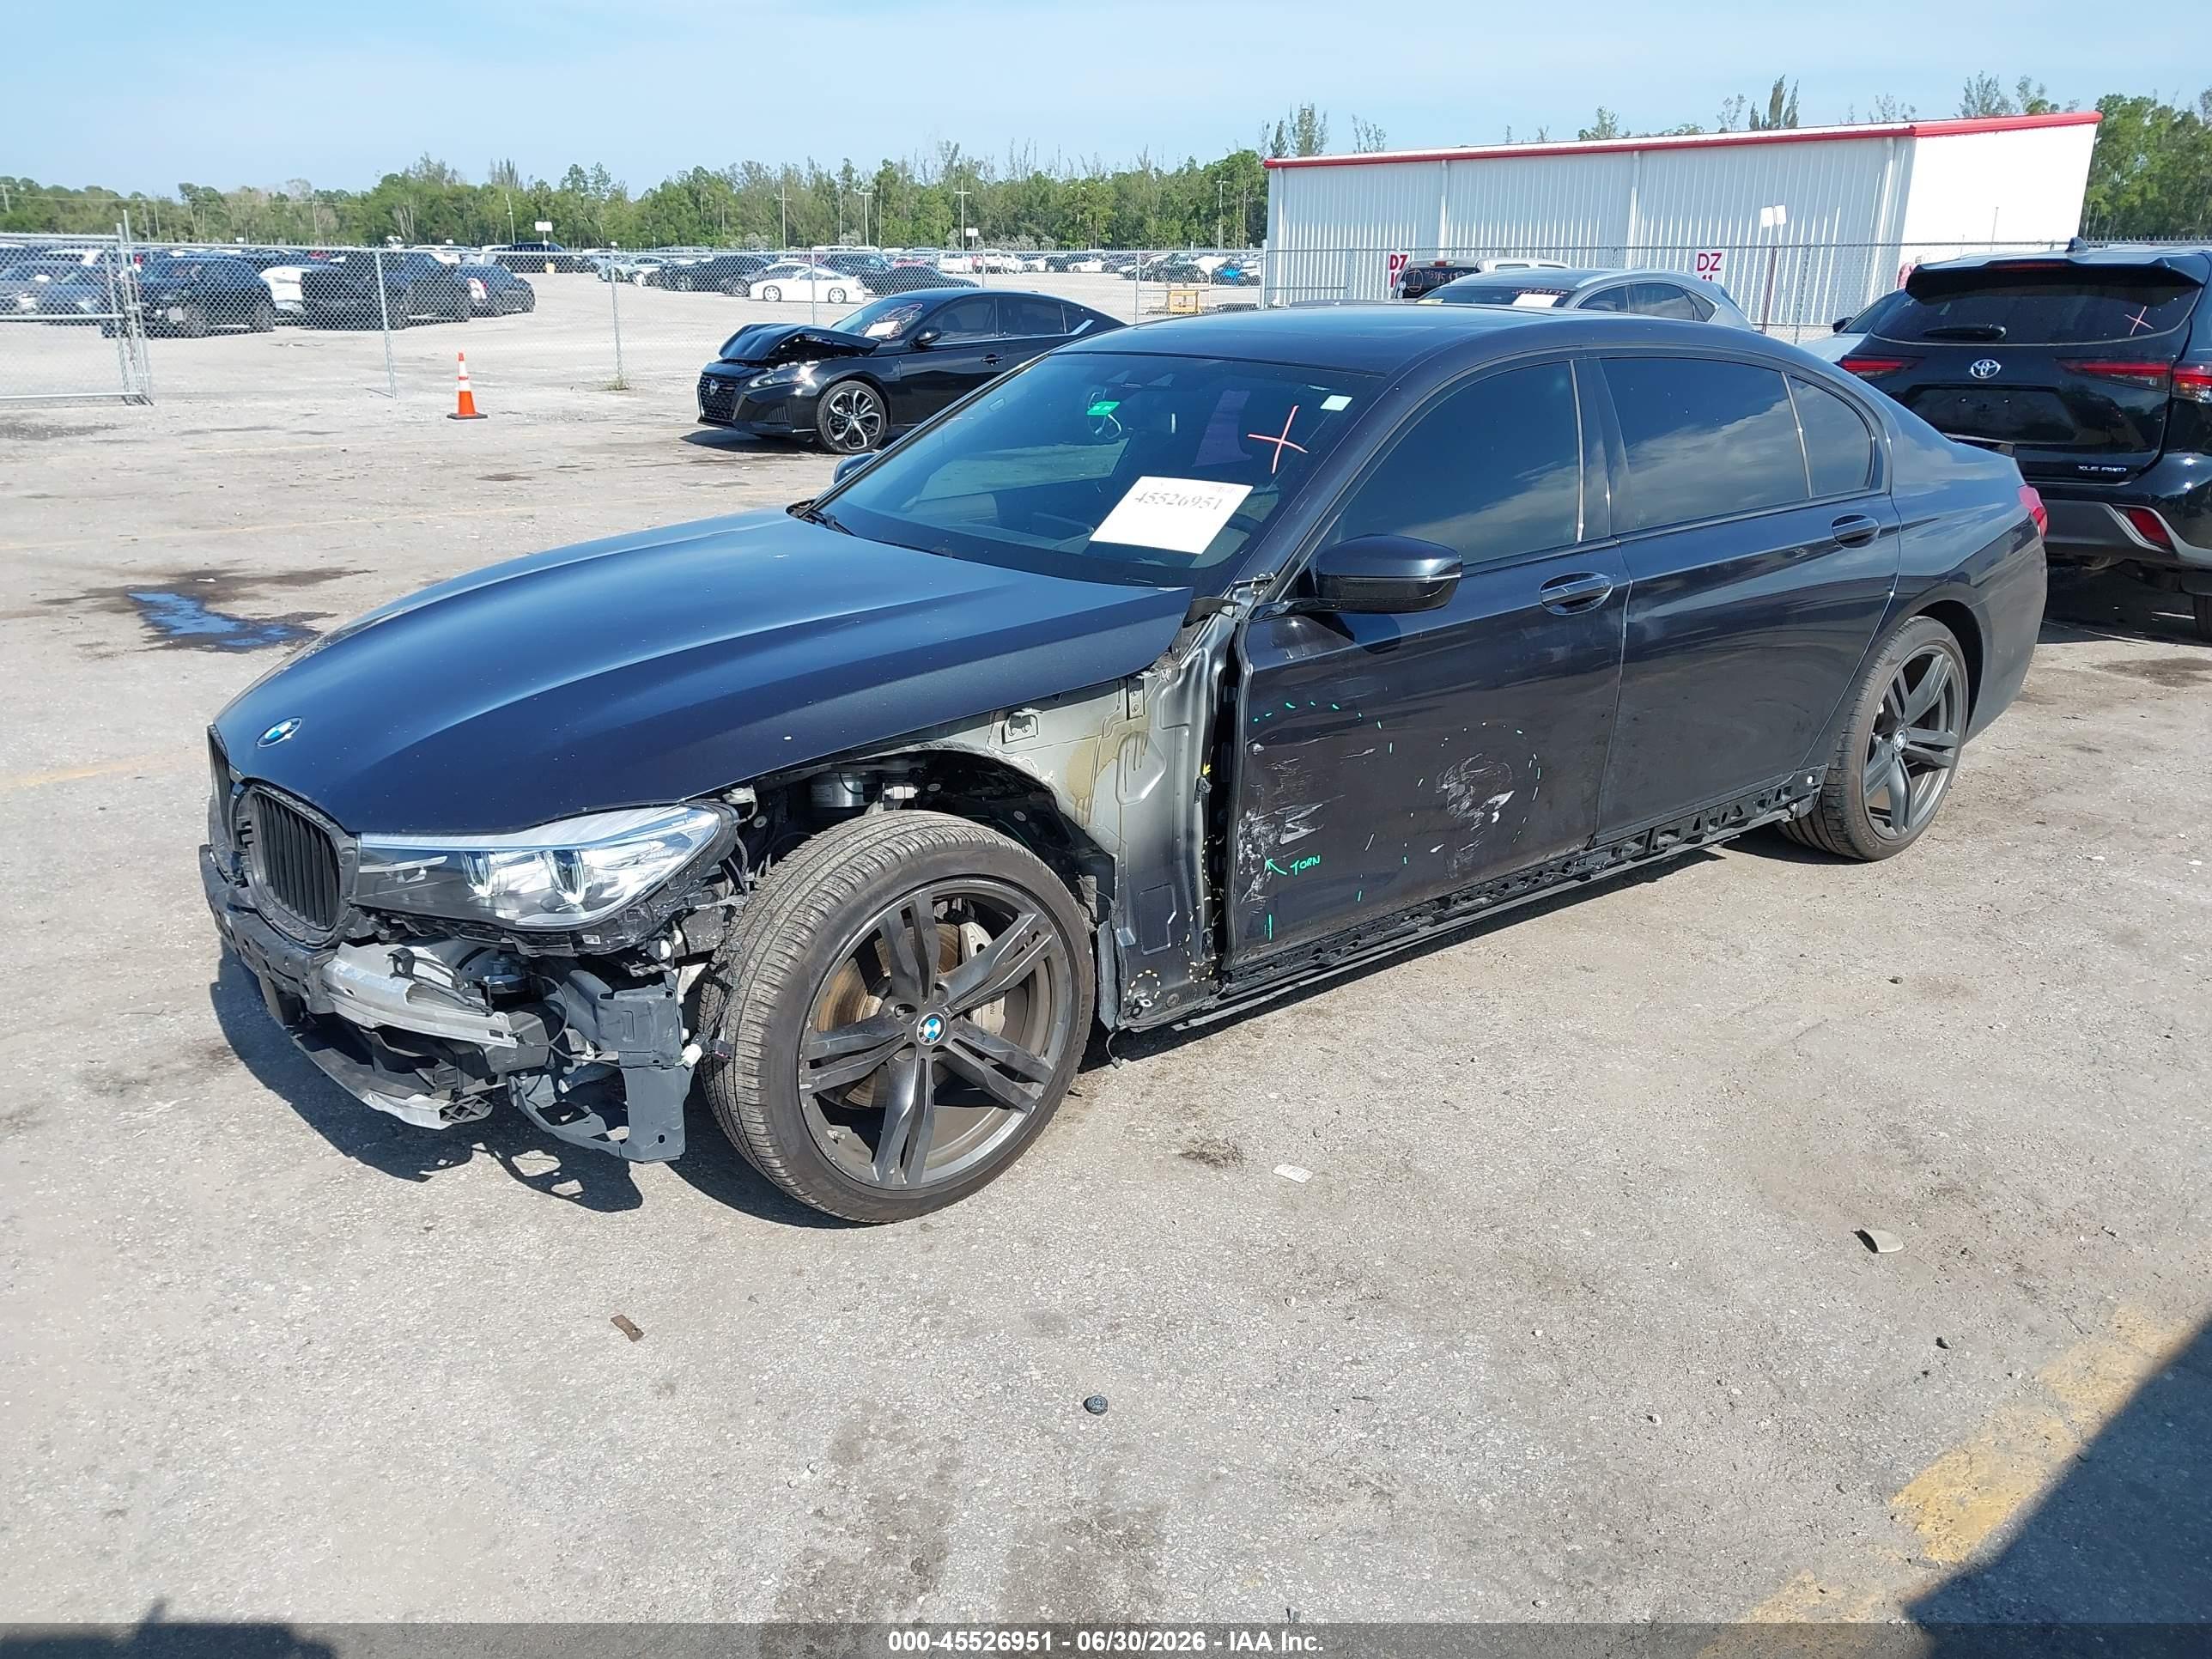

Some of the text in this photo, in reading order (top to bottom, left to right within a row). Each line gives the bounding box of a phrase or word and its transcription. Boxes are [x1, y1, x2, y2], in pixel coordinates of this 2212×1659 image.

[1697, 252, 1723, 271] DZ
[1135, 491, 1224, 511] 45526951
[1290, 855, 1321, 876] TORN
